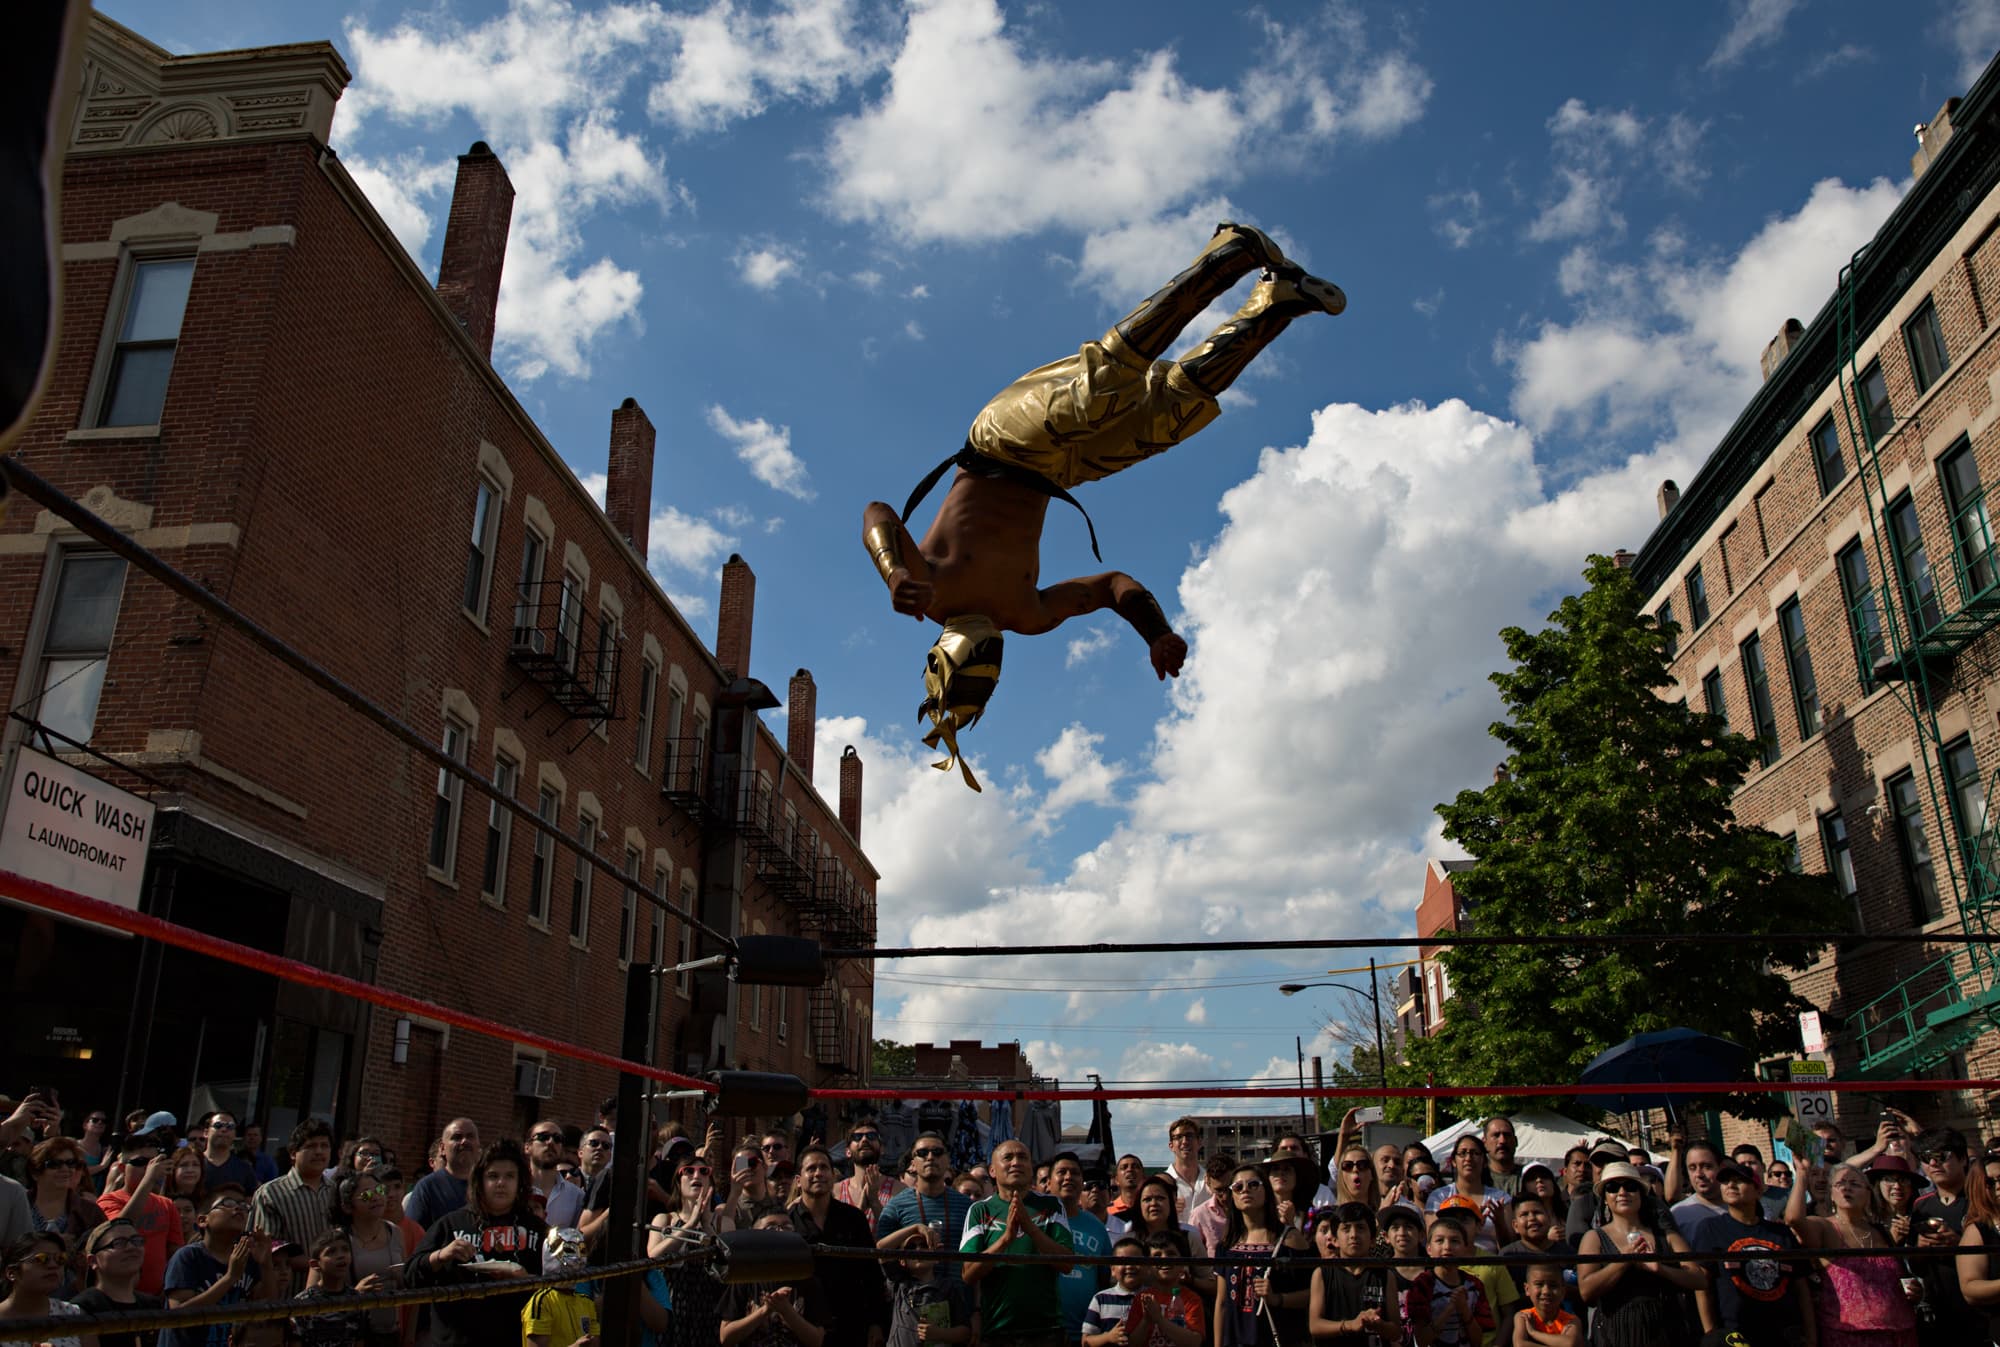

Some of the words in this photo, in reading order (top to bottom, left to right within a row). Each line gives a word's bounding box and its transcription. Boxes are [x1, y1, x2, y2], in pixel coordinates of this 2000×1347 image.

[24, 771, 87, 818] QUICK
[95, 799, 146, 842] WASH
[28, 822, 127, 872] LAUNDROMAT
[1792, 1063, 1825, 1073] SCHOOL
[1800, 1097, 1828, 1115] 20
